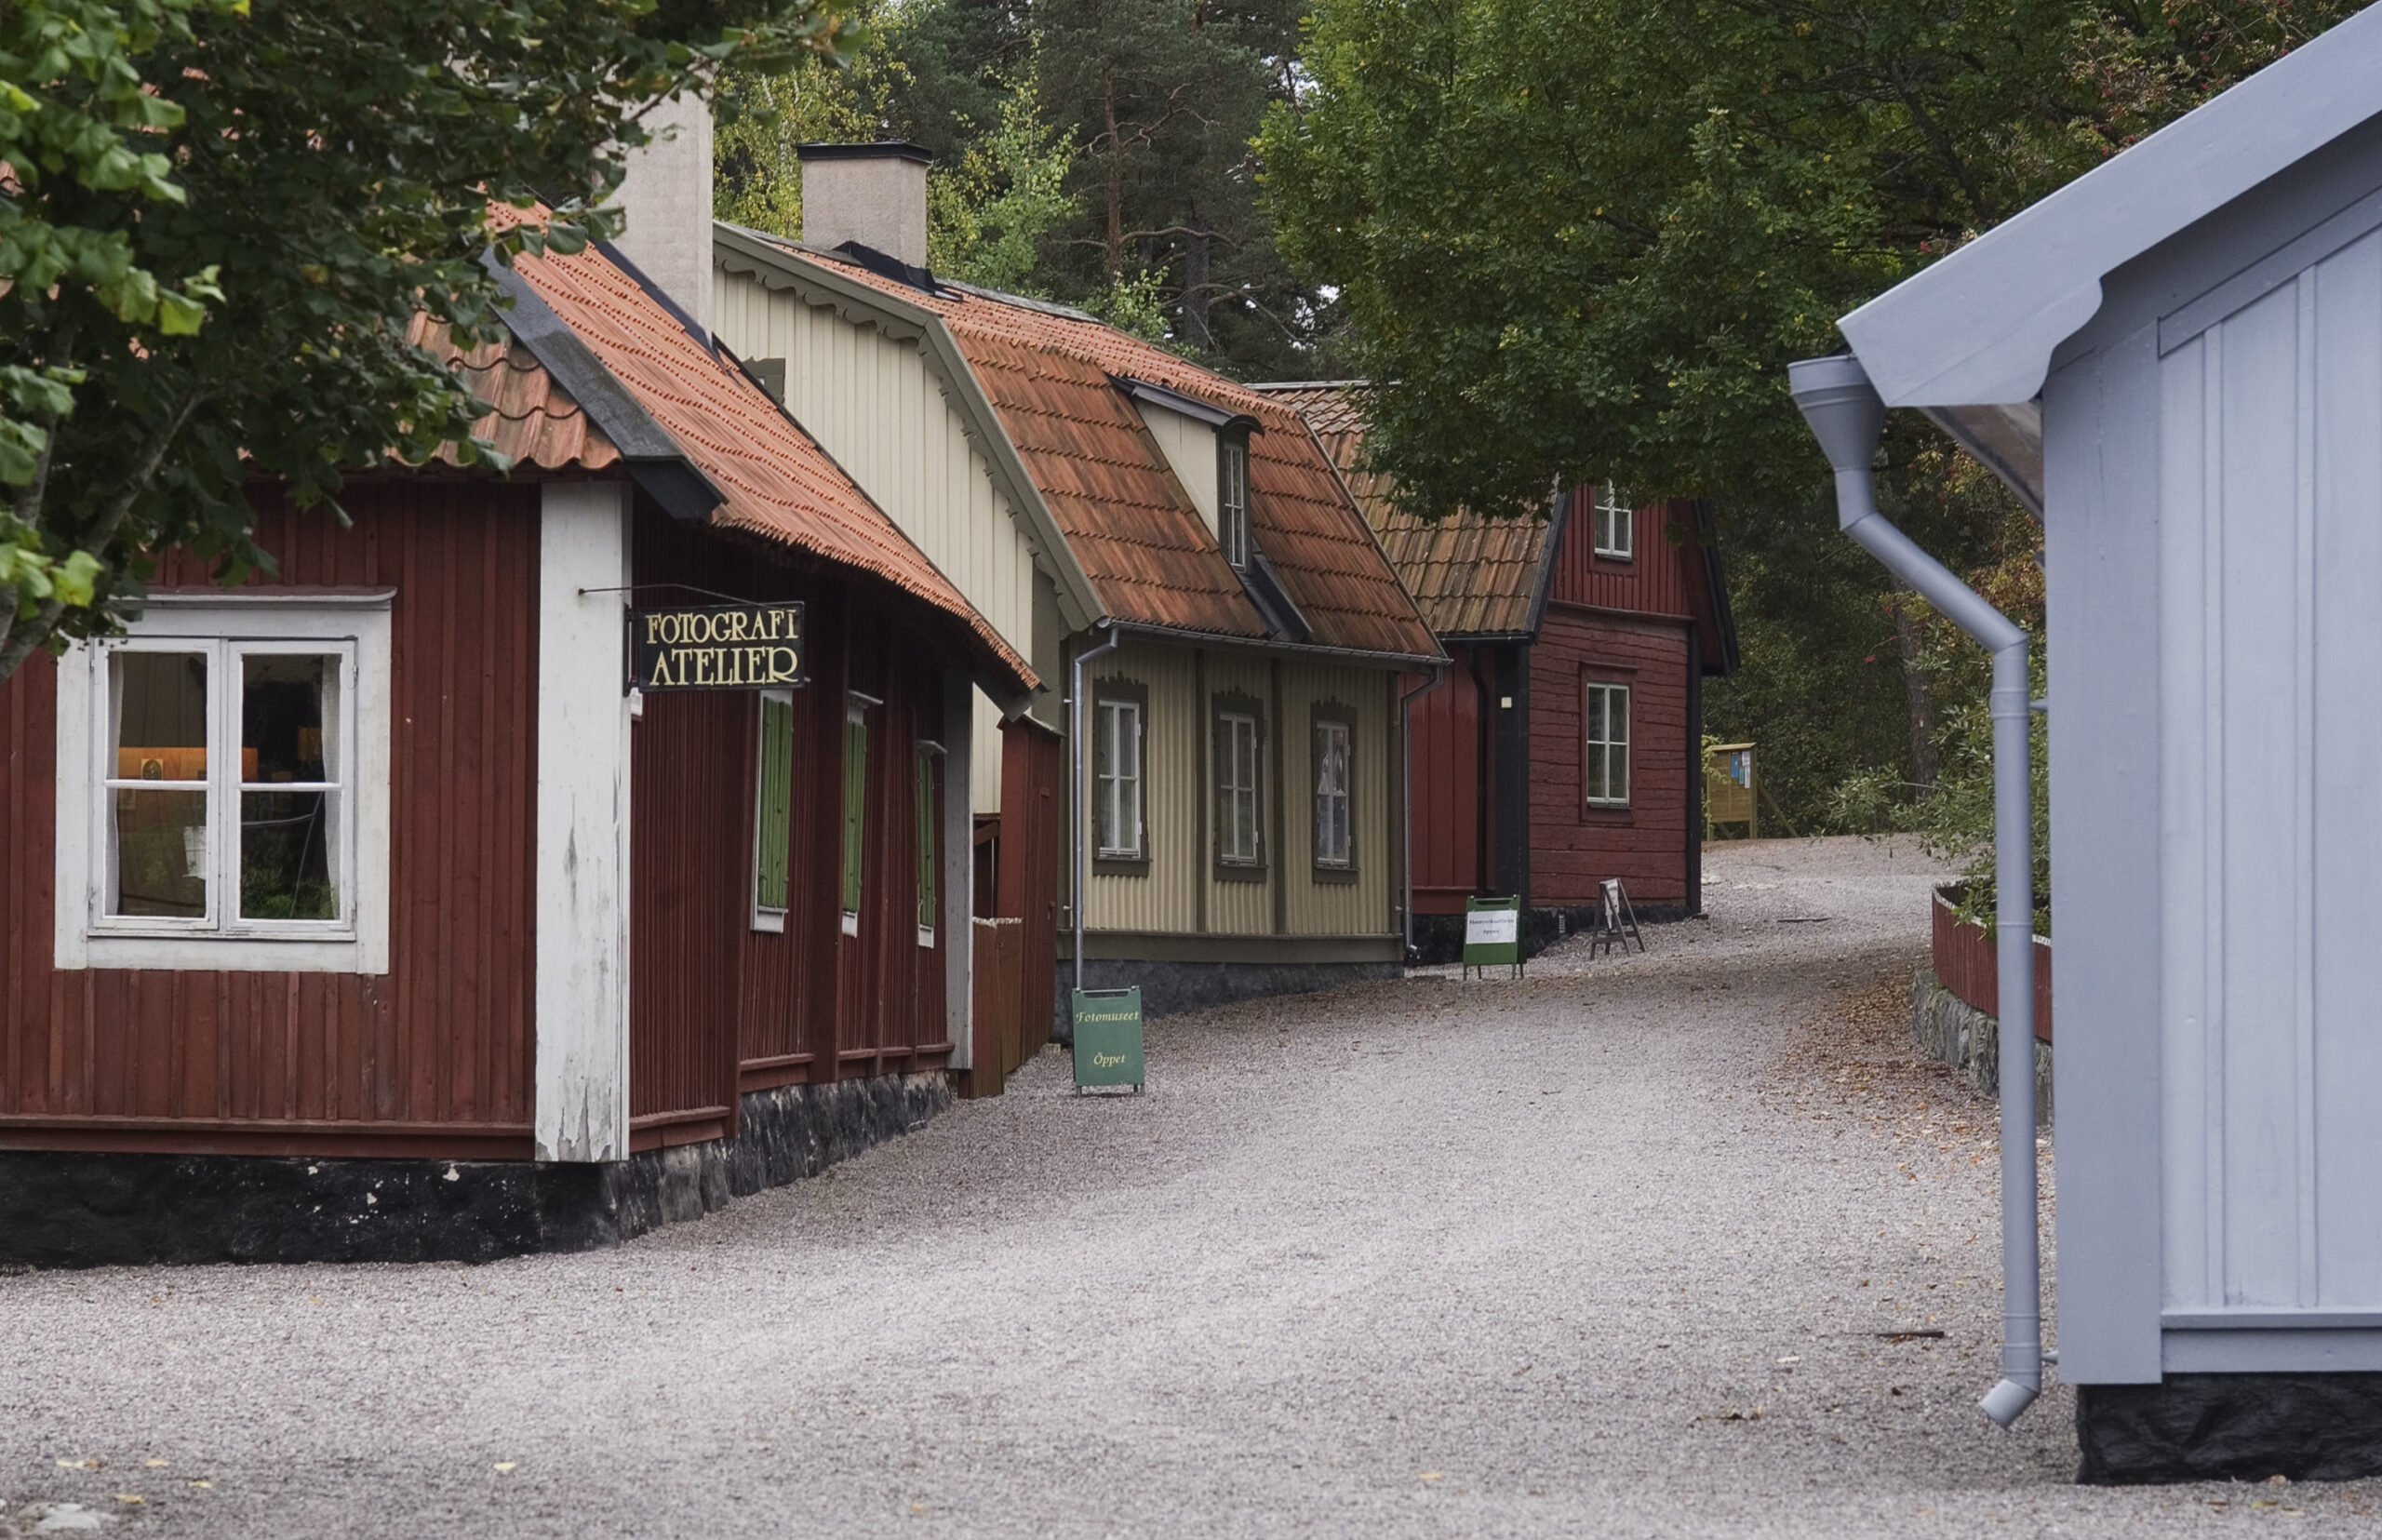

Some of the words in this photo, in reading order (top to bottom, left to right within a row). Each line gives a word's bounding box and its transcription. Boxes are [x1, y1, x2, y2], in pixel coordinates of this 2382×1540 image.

[646, 609, 798, 644] FOTOGRAFI
[649, 646, 798, 686] ATELIER
[1076, 1011, 1140, 1024] Fotomuseet
[1093, 1051, 1126, 1067] Öppet
